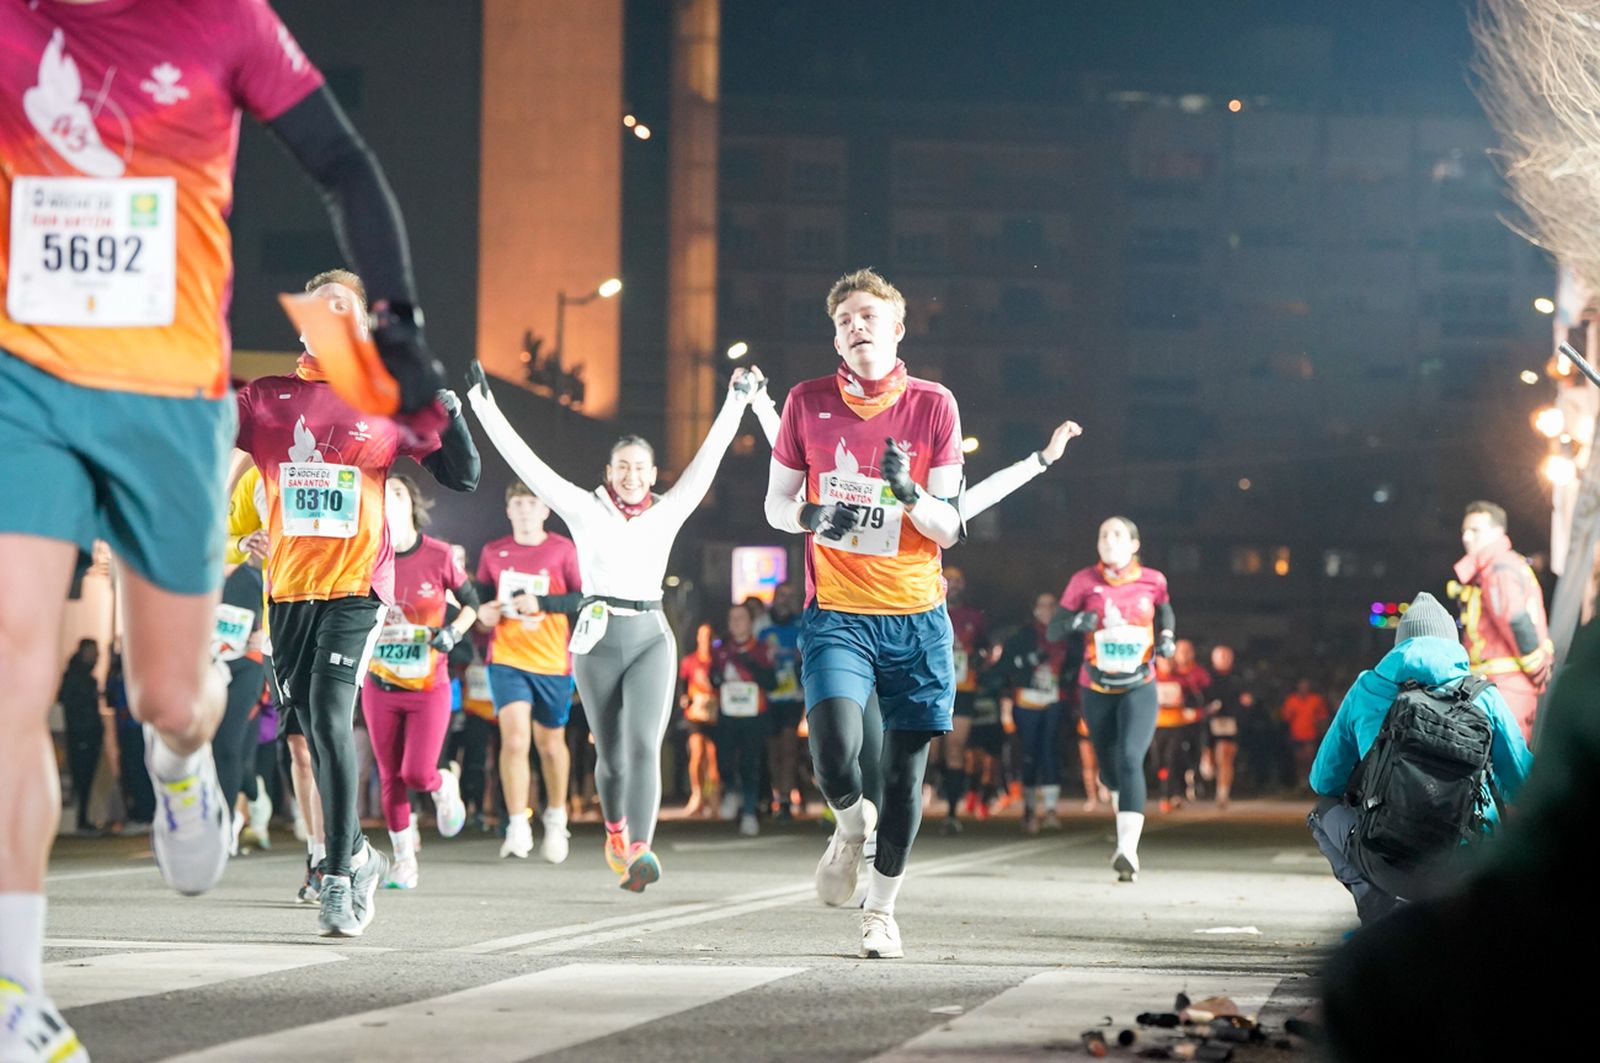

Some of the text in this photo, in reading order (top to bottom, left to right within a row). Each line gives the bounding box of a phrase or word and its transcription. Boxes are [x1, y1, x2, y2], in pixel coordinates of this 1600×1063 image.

[43, 233, 142, 273] 5692
[297, 470, 320, 479] NOCHE
[296, 488, 343, 512] 8310
